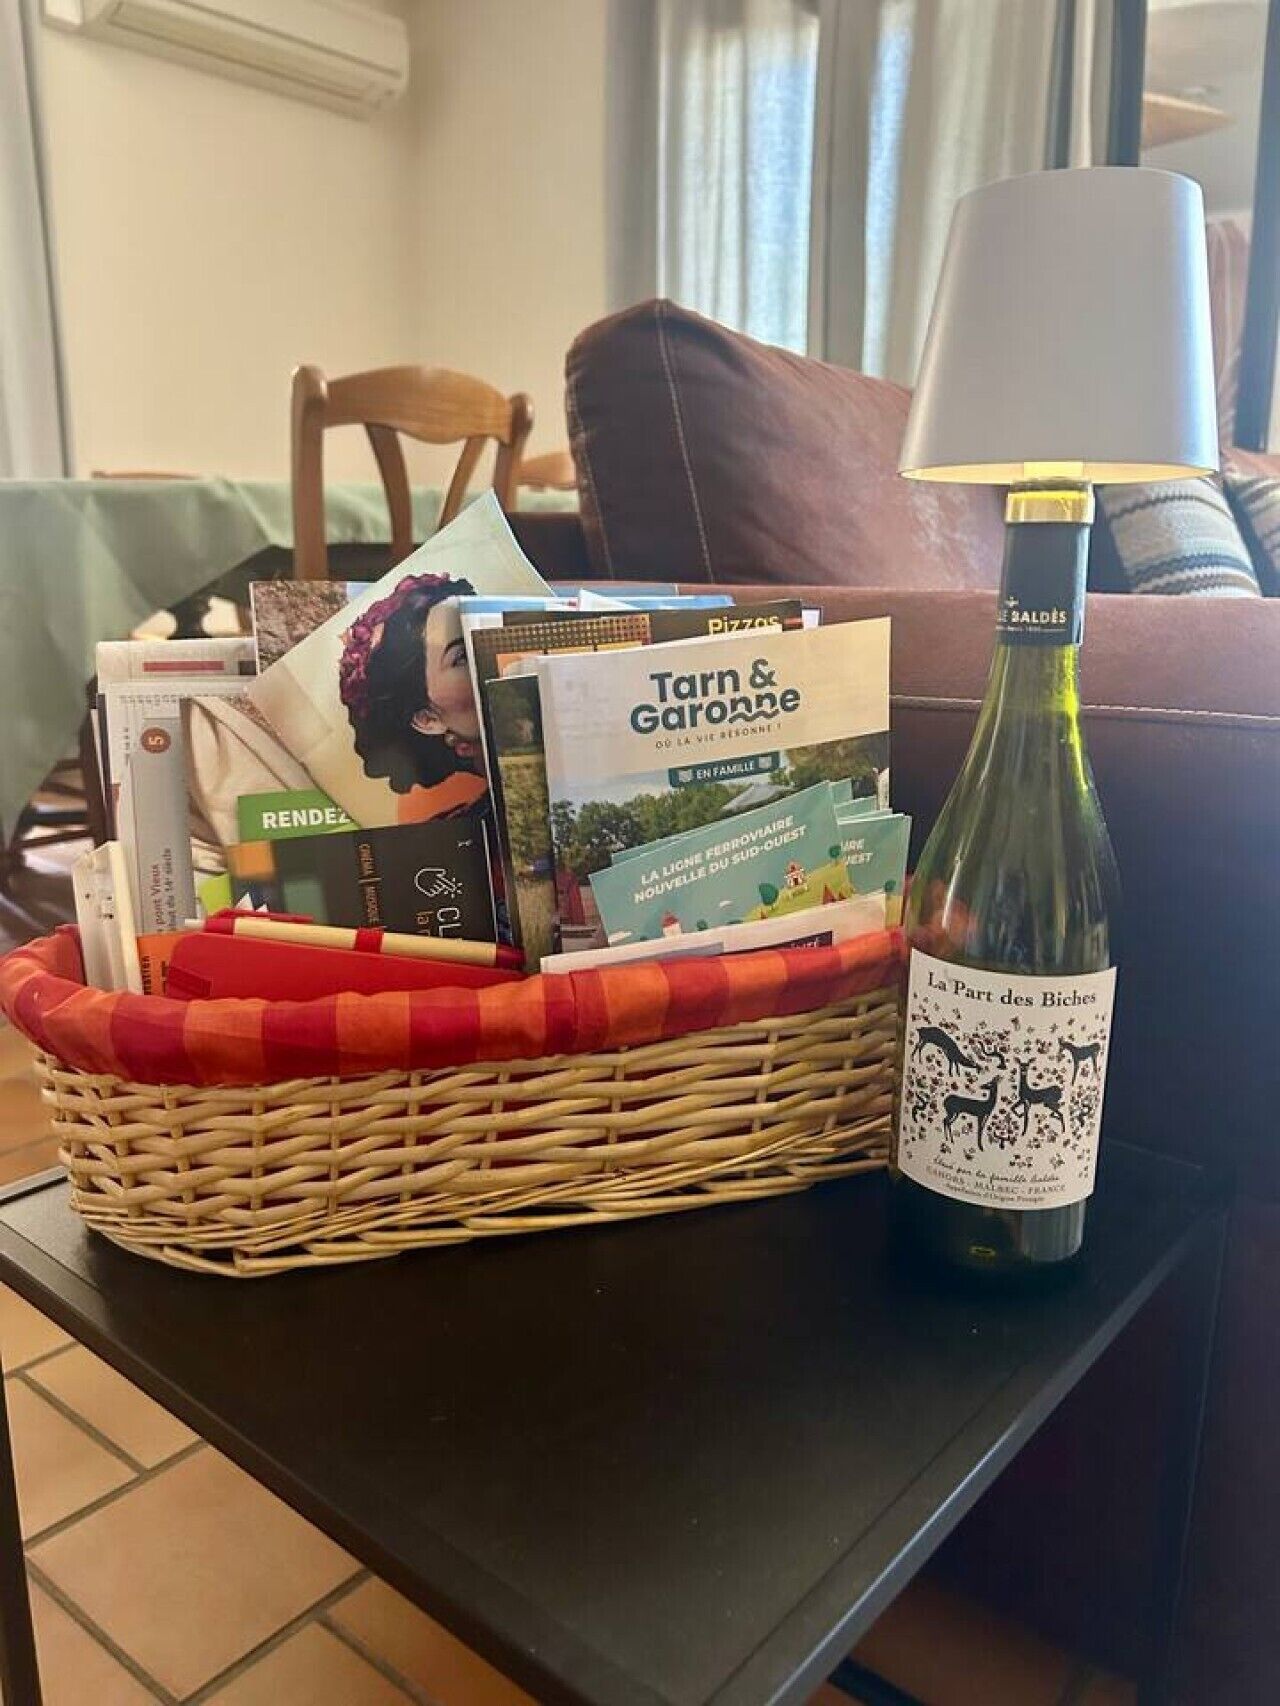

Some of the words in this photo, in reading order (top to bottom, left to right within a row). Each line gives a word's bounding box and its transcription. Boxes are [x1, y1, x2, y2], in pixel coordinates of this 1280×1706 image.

[650, 669, 740, 702] Tarn
[750, 658, 777, 689] &
[630, 688, 801, 734] Garonne
[148, 735, 164, 746] 5
[677, 736, 691, 748] LA
[697, 732, 715, 744] VIE
[696, 769, 711, 780] EN
[713, 761, 755, 777] FAMILLE
[634, 869, 708, 904] NOUVELLE
[709, 859, 730, 874] DU
[732, 824, 807, 865] SUD-OUEST
[641, 872, 660, 886] LA
[662, 854, 703, 877] LIGNE
[705, 815, 794, 861] FERROVIAIRE
[928, 971, 947, 992] La
[954, 980, 993, 1003] Part
[1000, 988, 1034, 1007] des
[1041, 989, 1097, 1008] Biches
